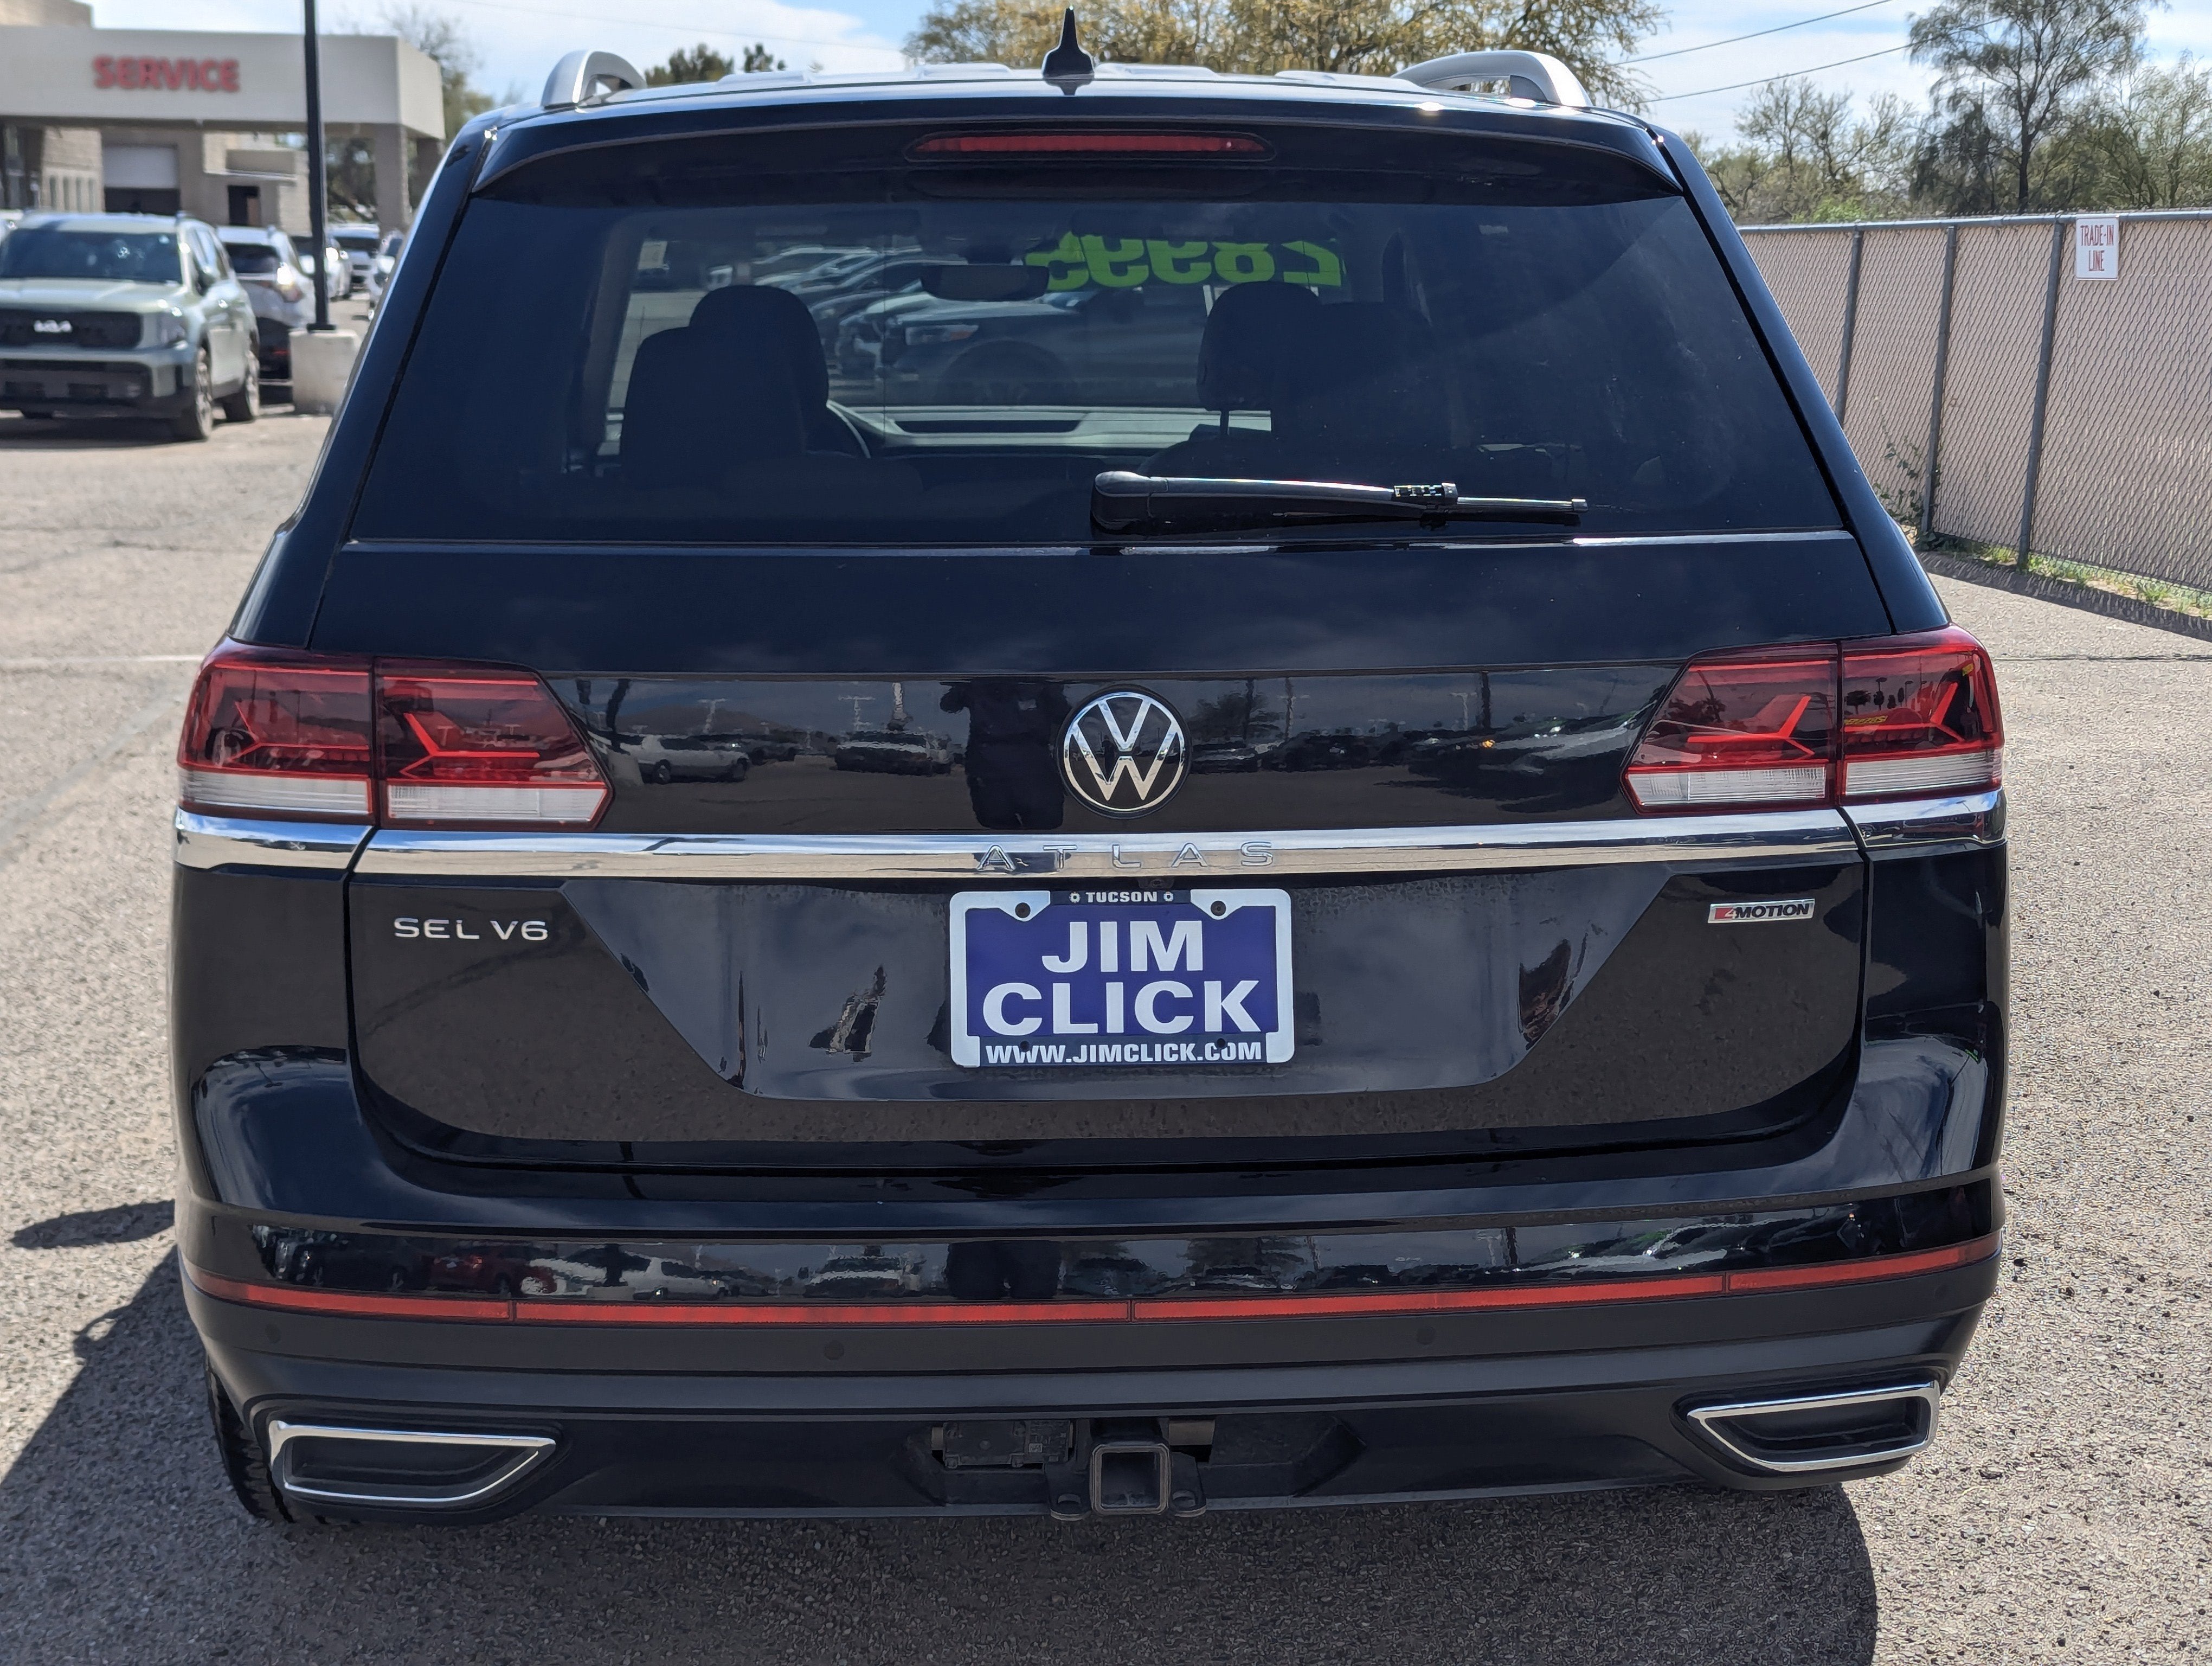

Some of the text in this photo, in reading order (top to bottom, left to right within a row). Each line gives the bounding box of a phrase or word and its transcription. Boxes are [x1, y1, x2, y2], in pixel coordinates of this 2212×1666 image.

[93, 56, 240, 92] SERVICE
[2080, 225, 2114, 246] TRADE-IN
[2089, 250, 2105, 271] LINE
[977, 841, 1273, 872] ATLAS
[1085, 891, 1157, 902] TUCSON
[1724, 903, 1809, 920] 4MOTION
[394, 918, 548, 940] SEL V6
[1041, 920, 1203, 973] JIM
[982, 980, 1262, 1035] CLICK
[985, 1041, 1262, 1064] WWW.JIMCLICK.COM
